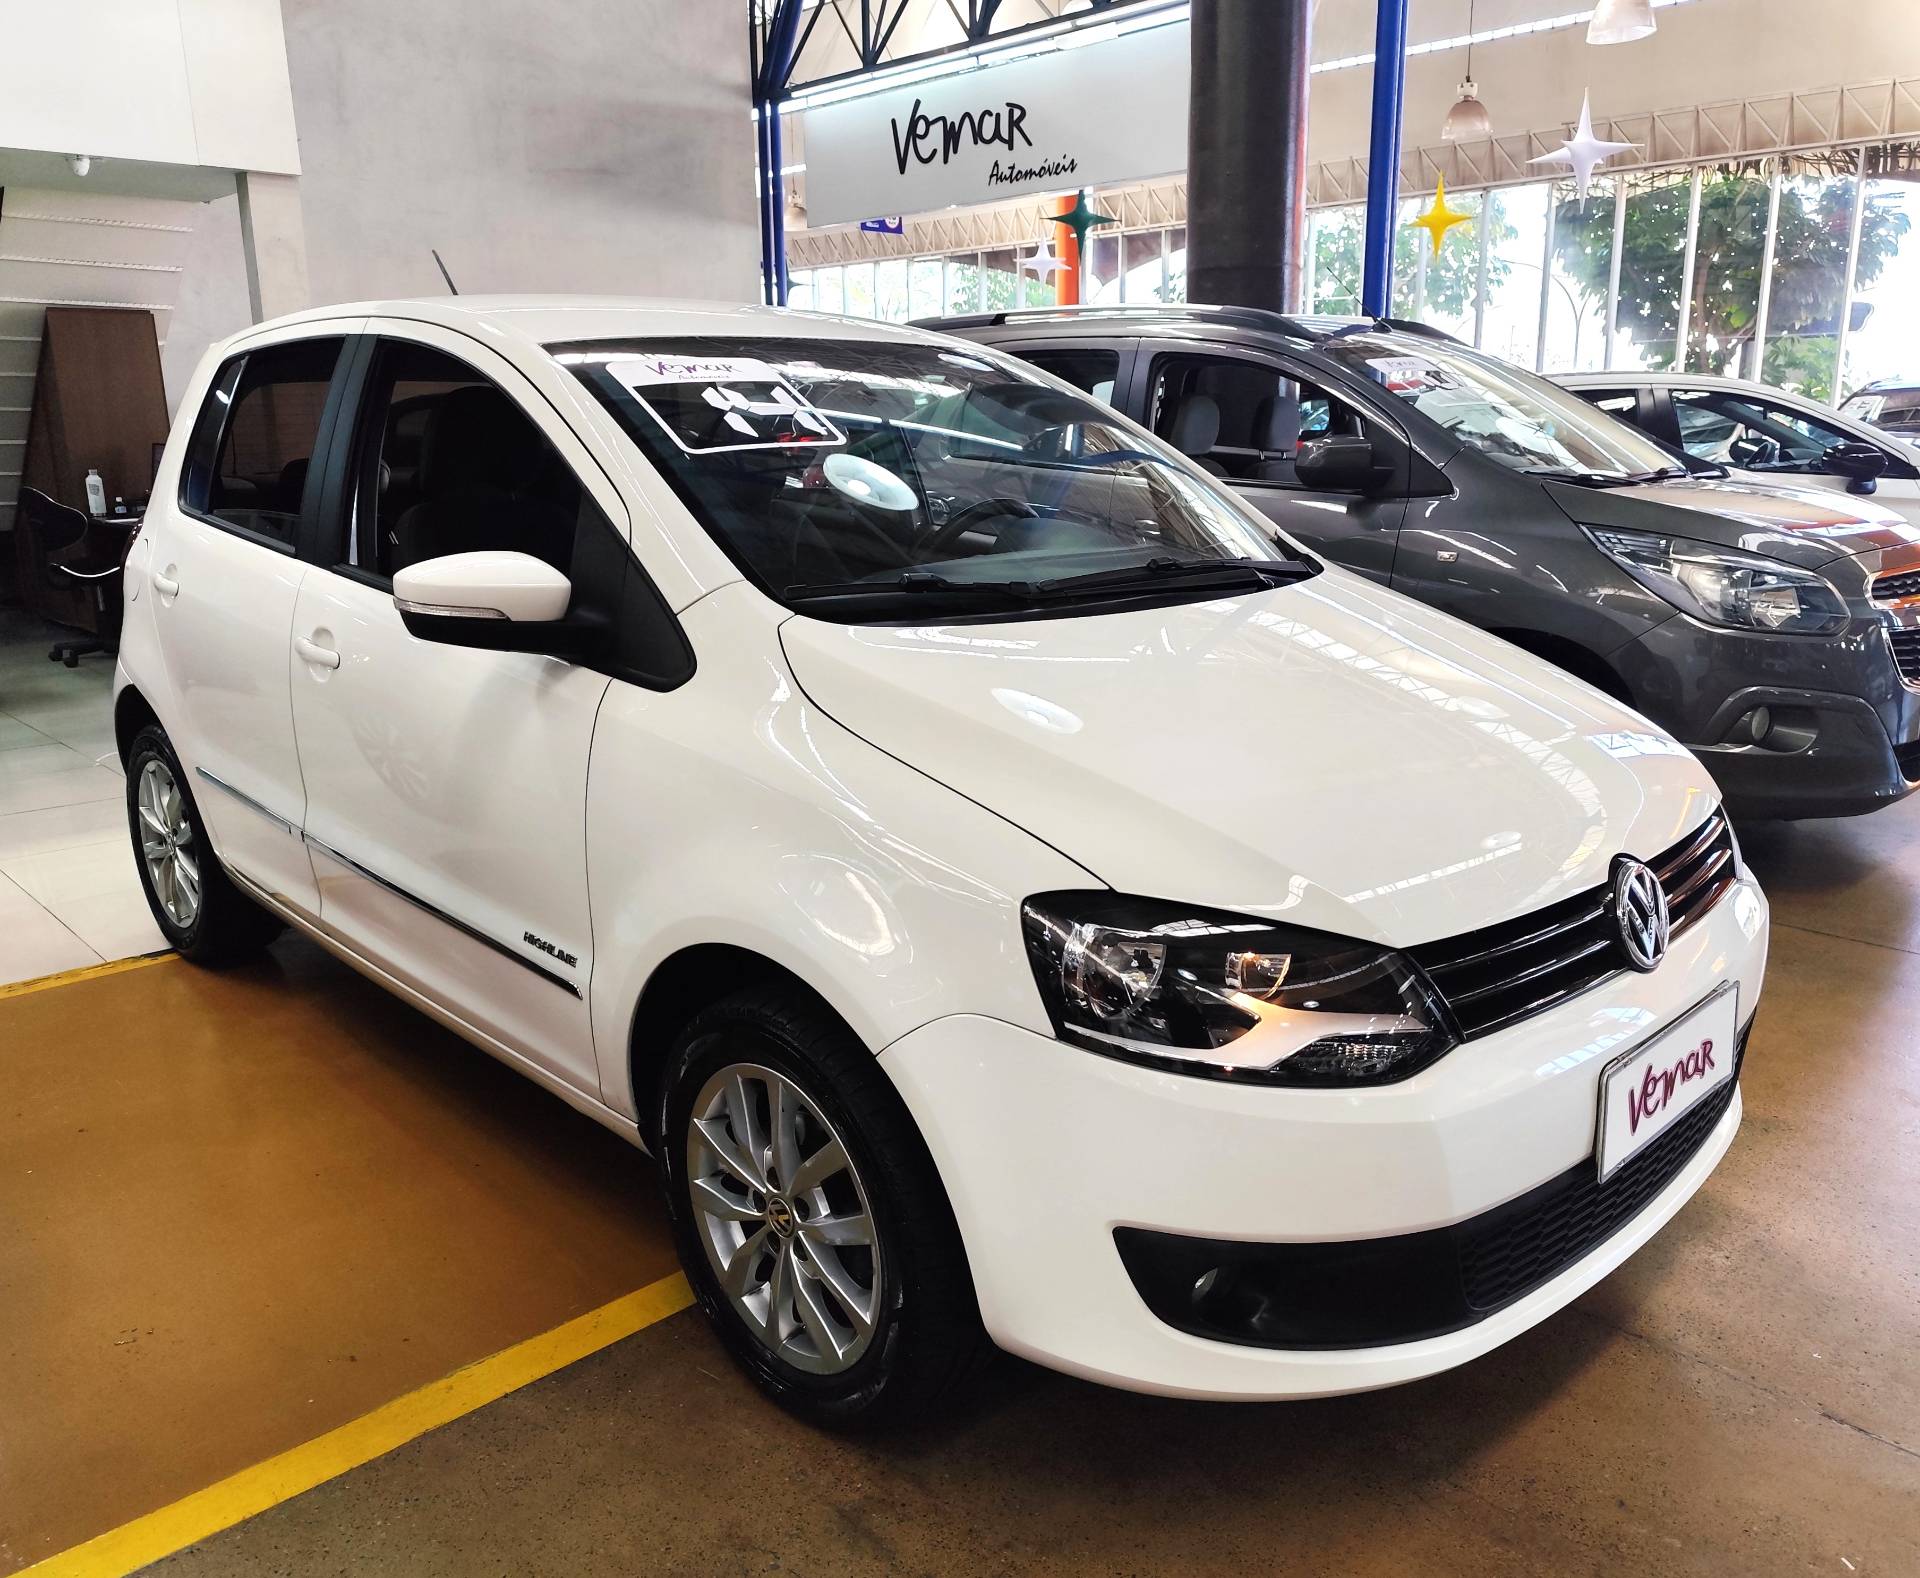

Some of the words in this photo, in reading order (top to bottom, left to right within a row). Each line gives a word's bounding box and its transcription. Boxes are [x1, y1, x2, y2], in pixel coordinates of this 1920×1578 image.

[988, 153, 1078, 186] Automóveis
[701, 386, 828, 437] 14
[523, 931, 578, 968] HIGHLINE
